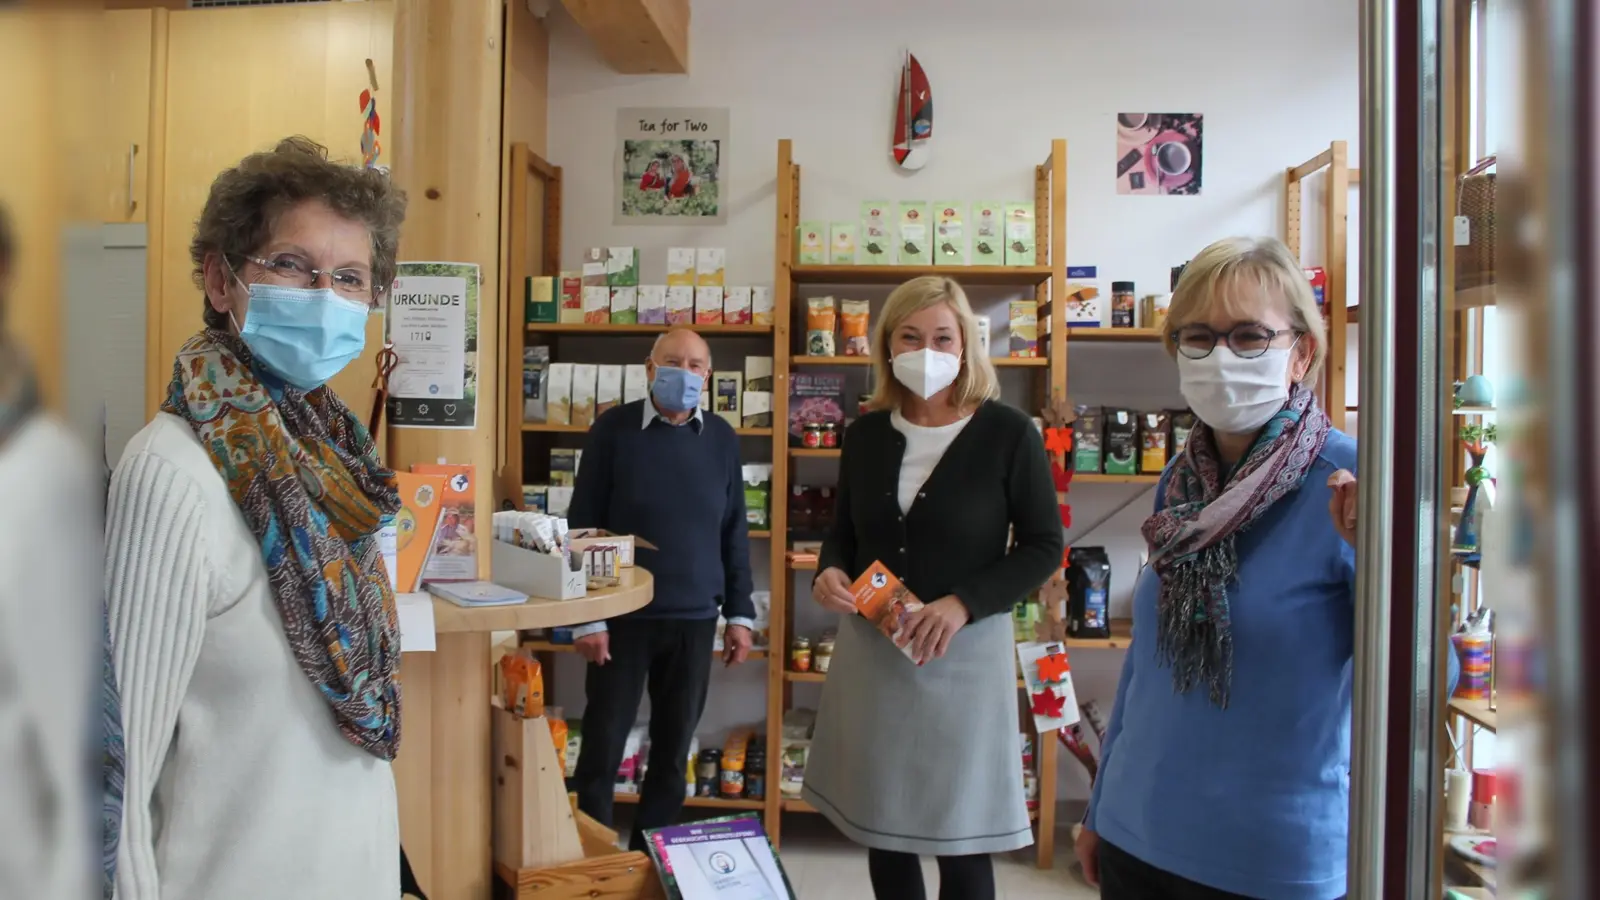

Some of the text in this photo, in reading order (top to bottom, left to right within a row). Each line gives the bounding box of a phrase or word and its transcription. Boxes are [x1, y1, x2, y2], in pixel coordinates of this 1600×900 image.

[638, 118, 708, 135] Tea for Two
[394, 293, 460, 306] URKUNDE
